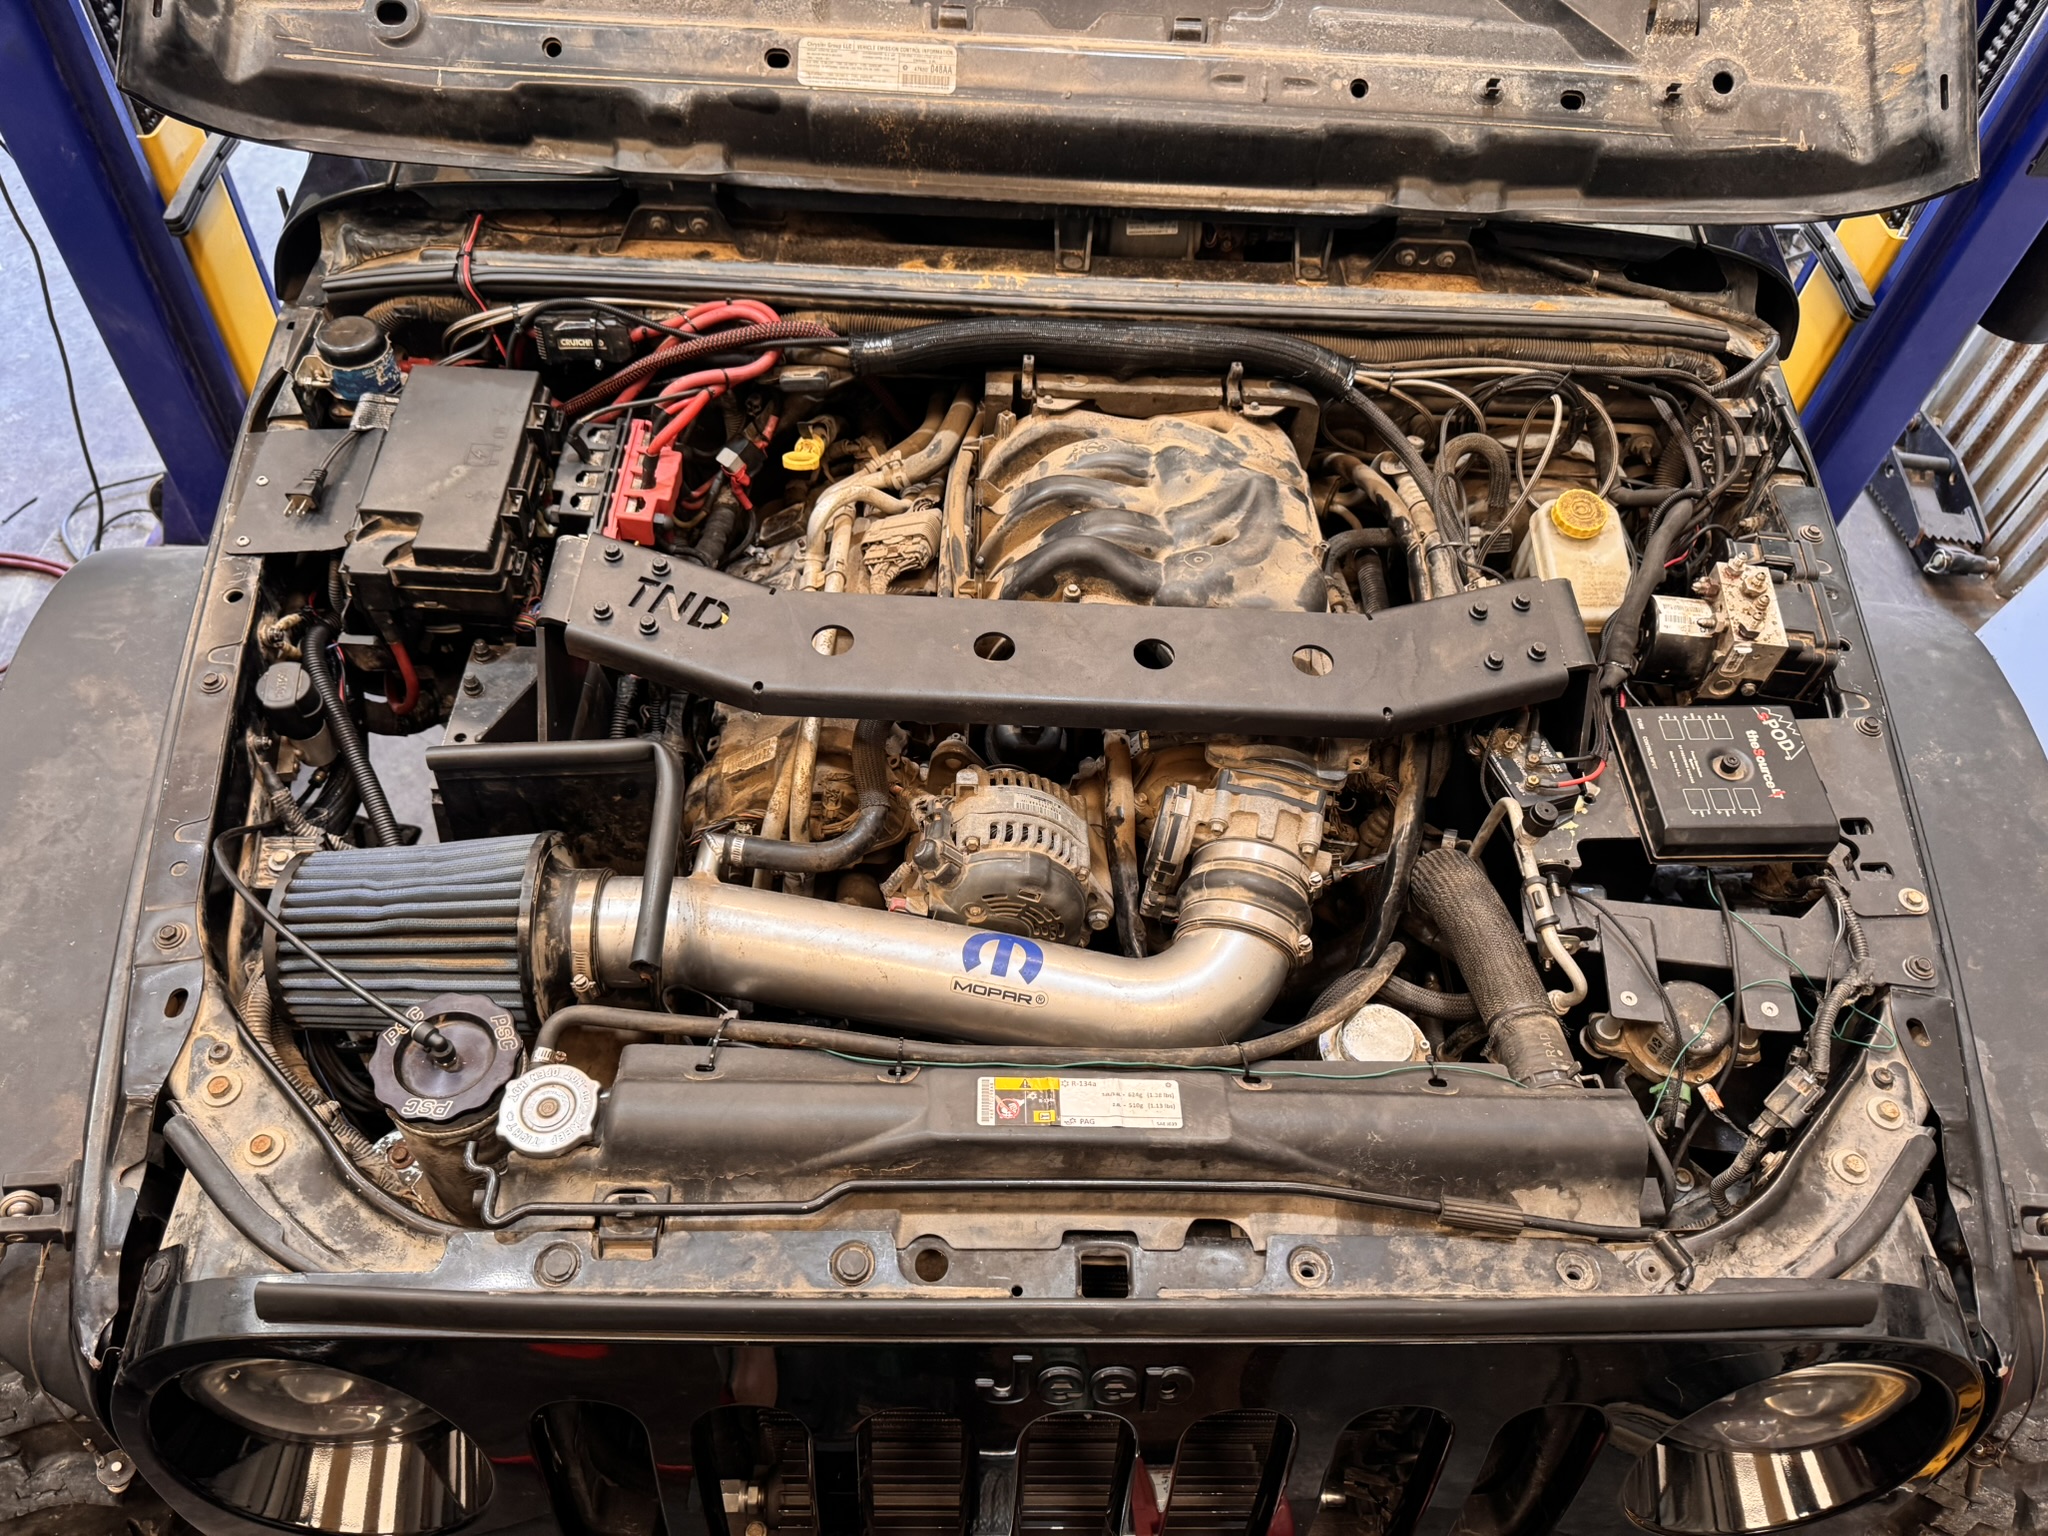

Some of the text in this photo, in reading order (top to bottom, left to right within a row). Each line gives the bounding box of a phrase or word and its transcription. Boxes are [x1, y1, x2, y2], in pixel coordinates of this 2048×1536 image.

[627, 576, 731, 630] TND
[490, 1013, 519, 1051] PSC
[529, 1067, 560, 1083] OPEN
[507, 1080, 529, 1103] HOT
[401, 1097, 454, 1118] PSC
[974, 1354, 1196, 1413] Jeep
